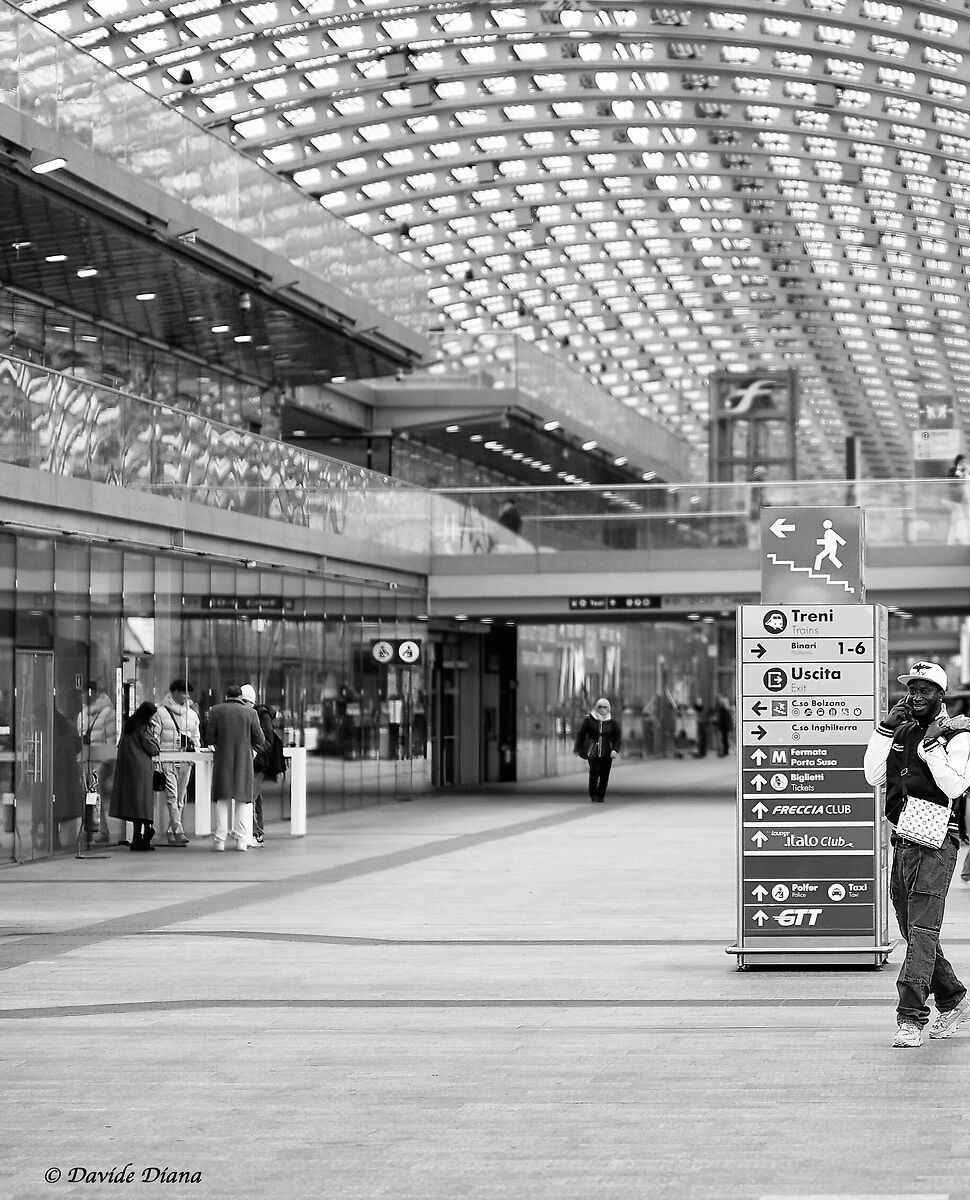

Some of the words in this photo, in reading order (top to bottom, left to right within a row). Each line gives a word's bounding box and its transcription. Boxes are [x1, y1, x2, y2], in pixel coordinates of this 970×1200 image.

[791, 608, 834, 622] Treni
[792, 625, 819, 635] Trains
[791, 642, 817, 650] Binari
[837, 641, 866, 655] 1-6
[791, 666, 842, 680] Uscita
[791, 683, 807, 693] Exit
[791, 699, 809, 707] C.so
[811, 699, 846, 707] Bolzano
[791, 724, 809, 732] C.so
[811, 723, 858, 733] Inghilterra
[771, 750, 787, 764] M
[790, 748, 828, 756] Fermata
[790, 758, 816, 766] Porta
[816, 758, 838, 766] Susa
[790, 773, 825, 783] Biglietti
[791, 783, 815, 792] Tickets
[772, 805, 824, 815] FRECCIA
[825, 804, 852, 814] CLUB
[820, 836, 846, 847] Club
[791, 883, 819, 892] Polfer
[848, 883, 868, 891] Taxi
[773, 908, 823, 927] GTT
